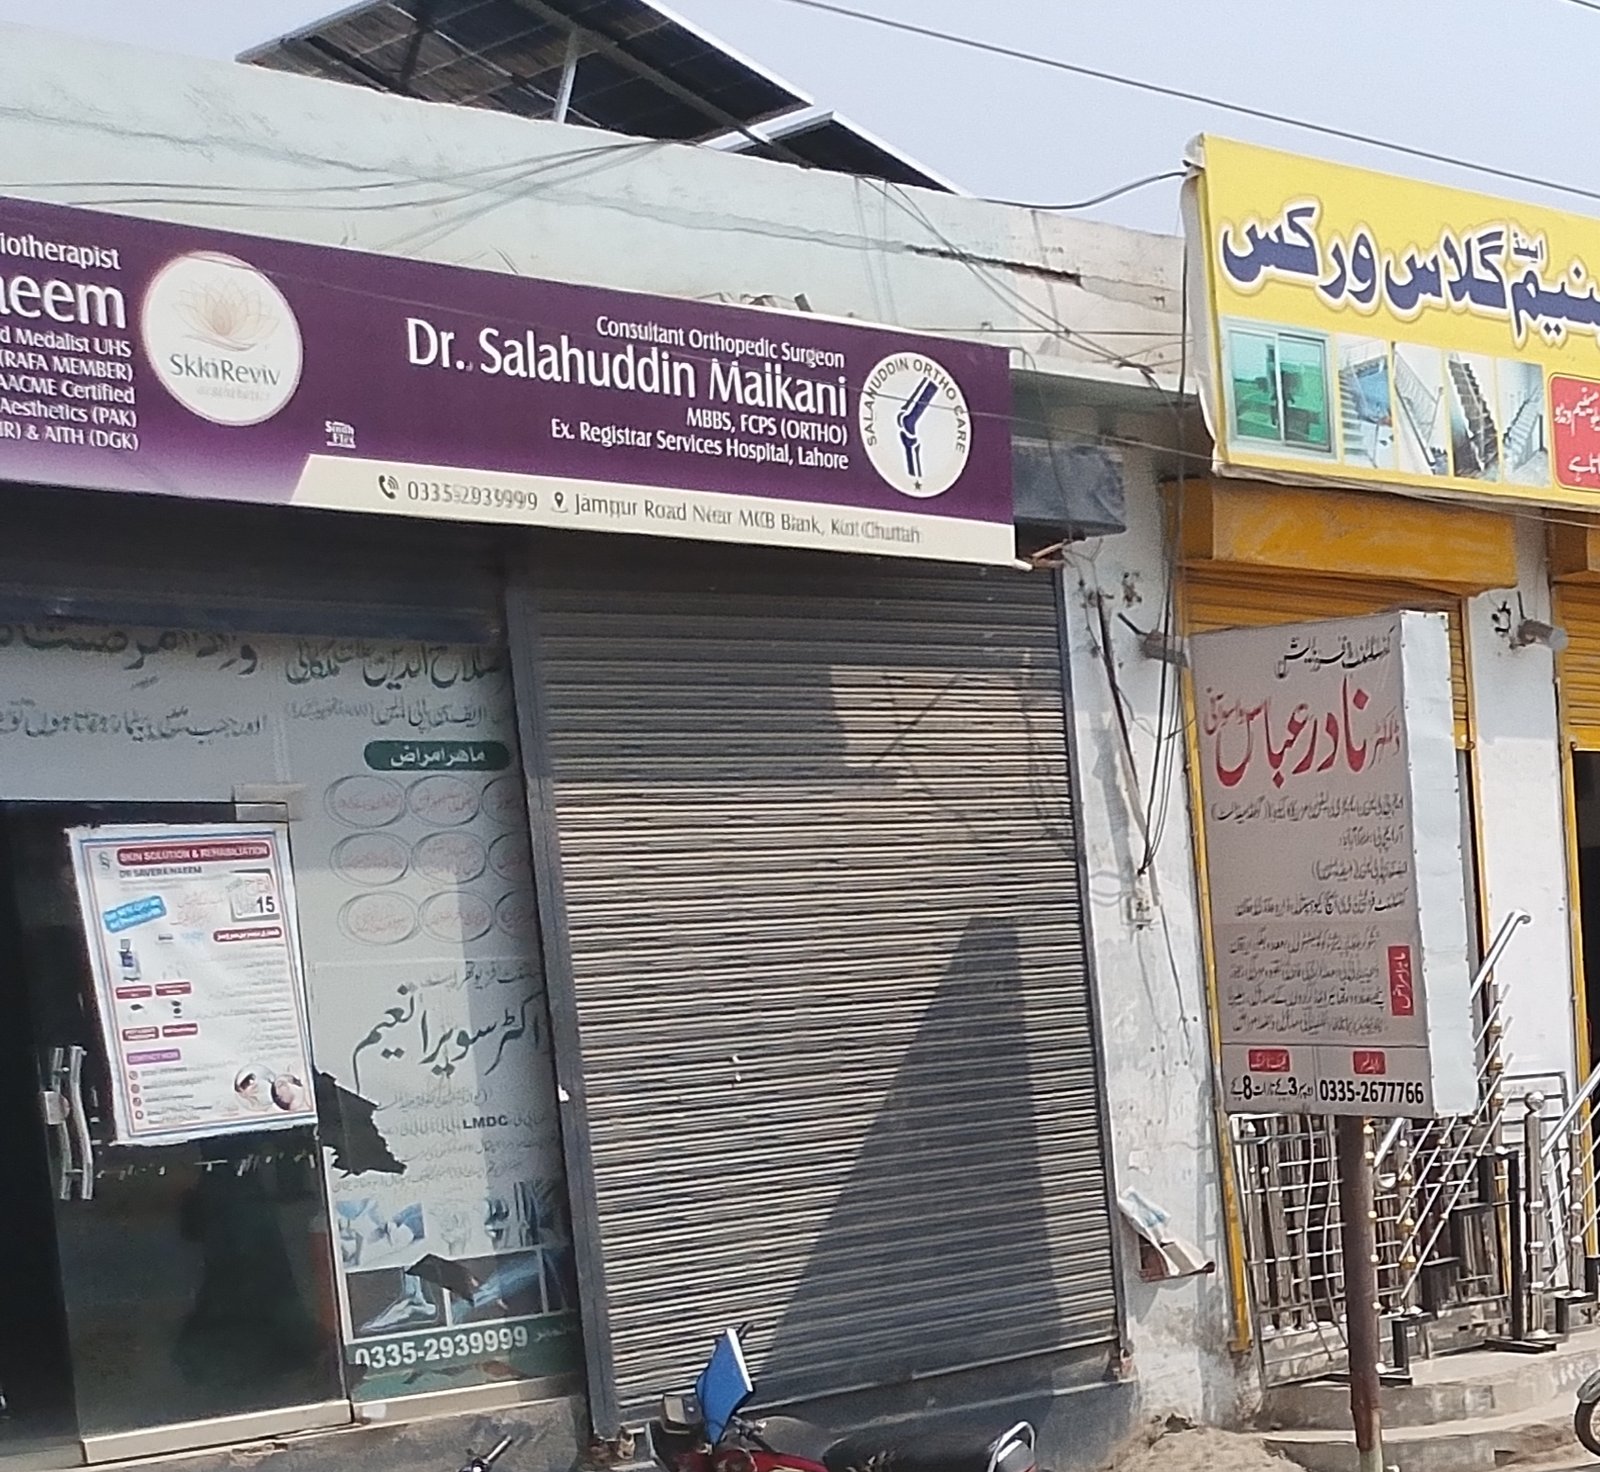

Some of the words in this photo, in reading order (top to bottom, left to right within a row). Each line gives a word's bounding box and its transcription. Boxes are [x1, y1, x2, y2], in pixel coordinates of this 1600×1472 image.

[1222, 206, 1378, 302] ورکس
[1386, 230, 1510, 311] گلاس
[15, 327, 90, 353] Medalist
[94, 337, 132, 358] UHS
[596, 316, 685, 347] Consultant
[688, 328, 778, 359] Orthopedic
[781, 341, 845, 369] Surgeon
[53, 355, 134, 383] MEMBER)
[405, 317, 466, 371] Dr.
[478, 327, 696, 398] Salahuddin
[709, 358, 848, 417] Malkani
[61, 380, 136, 404] Certified
[913, 359, 958, 400] ORTHO
[953, 405, 967, 454] CARE
[0, 397, 89, 422] Aesthetics
[92, 405, 137, 428] (PAK)
[686, 406, 737, 433] MBBS,
[740, 414, 778, 437] FCPS
[780, 418, 848, 446] (ORTHO)
[26, 424, 40, 441] &
[89, 430, 139, 451] (DGK)
[551, 418, 576, 440] Ex.
[579, 421, 652, 448] Registrar
[656, 429, 723, 455] Services
[726, 438, 794, 466] Hospital,
[798, 446, 850, 470] Lahore
[644, 499, 687, 522] Road
[256, 896, 275, 913] 15
[1242, 1075, 1252, 1100] 8
[1288, 1076, 1297, 1095] 3
[1319, 1080, 1424, 1104] 0335-2677766
[463, 1116, 509, 1130] LMDC
[355, 1326, 529, 1369] 0335-2939999
